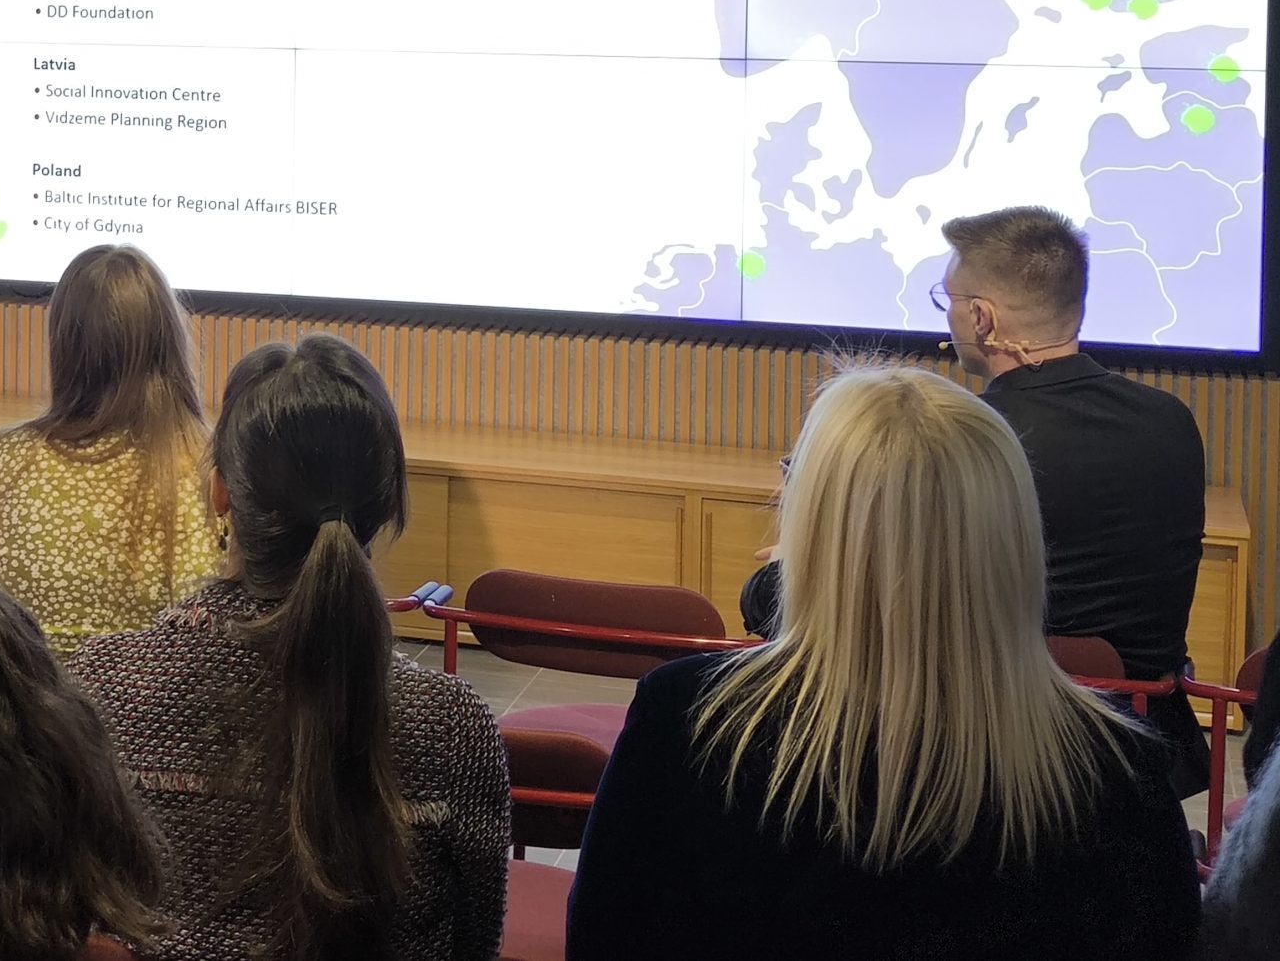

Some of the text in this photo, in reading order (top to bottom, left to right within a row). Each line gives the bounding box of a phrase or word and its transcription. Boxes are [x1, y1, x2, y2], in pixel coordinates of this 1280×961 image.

[47, 4, 154, 20] DD Foundation
[33, 57, 76, 71] Latvia
[46, 84, 221, 102] Social Innovation Centre
[45, 110, 227, 132] Vidzeme Planning Region
[32, 163, 82, 178] Poland
[45, 190, 337, 216] Baltic Institute for Regional Affairs BISER
[44, 216, 144, 235] City of Gdynia
